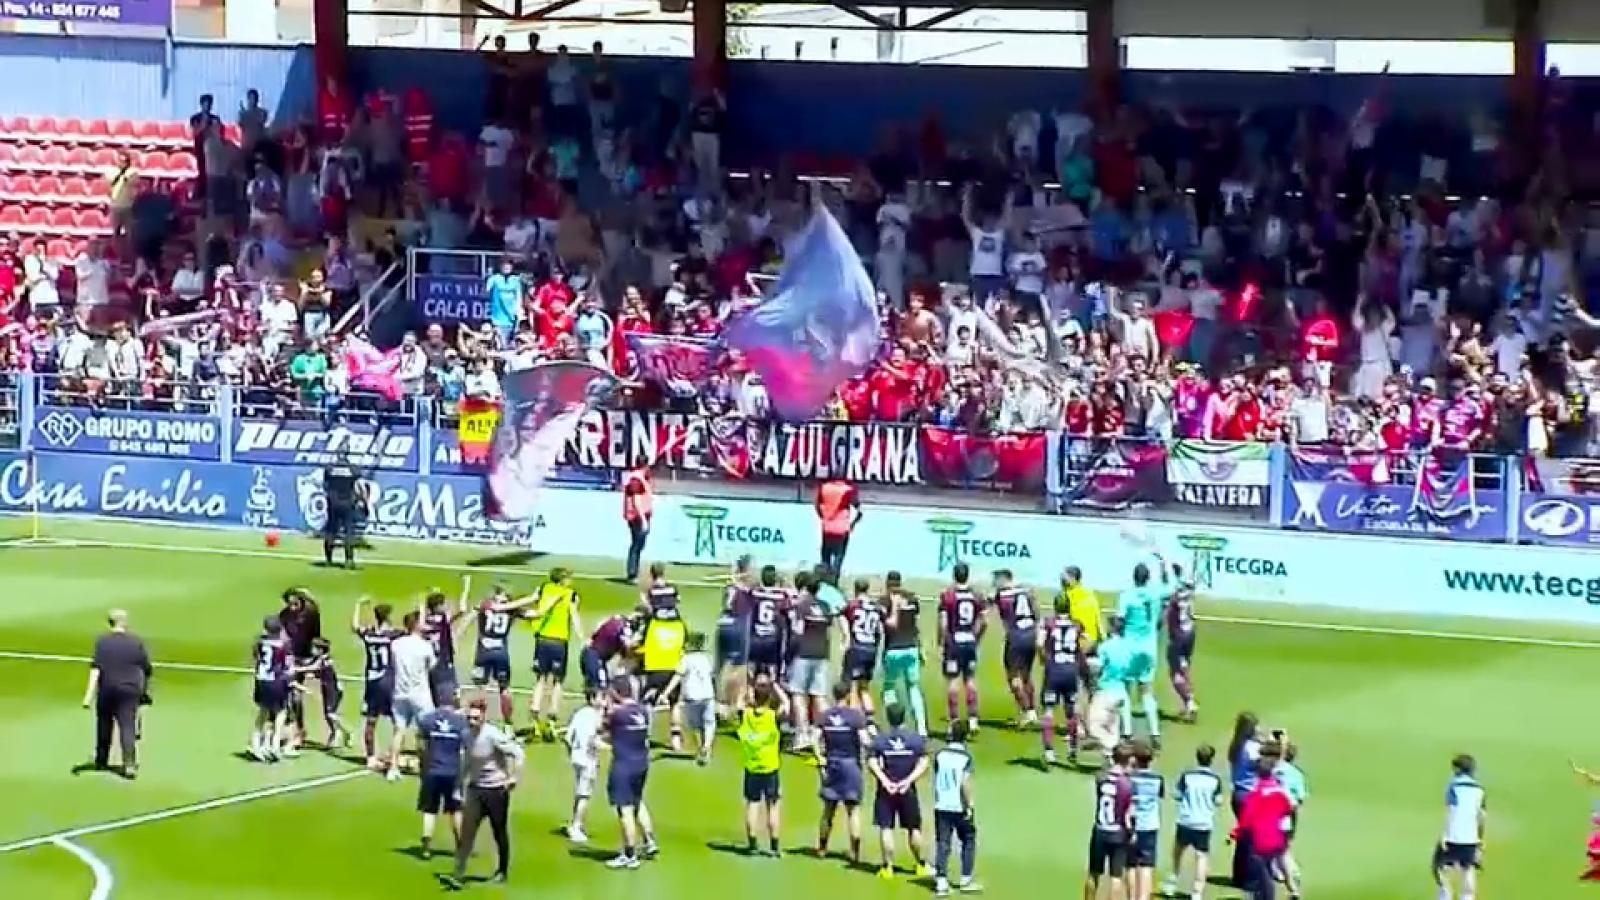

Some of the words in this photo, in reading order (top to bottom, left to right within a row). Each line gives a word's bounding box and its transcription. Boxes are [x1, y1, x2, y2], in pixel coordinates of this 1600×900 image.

[424, 298, 468, 318] CALA
[84, 416, 151, 438] GRUPO
[156, 420, 215, 442] ROMO
[555, 408, 709, 469] RENTE
[762, 421, 925, 484] AZULGRANA
[2, 459, 89, 508] Casa
[101, 465, 227, 516] Emilio
[716, 524, 786, 545] TECGRA
[960, 539, 1031, 559] TECGRA
[1214, 556, 1288, 577] TECGRA
[484, 609, 509, 634] 19
[759, 600, 775, 623] 6
[959, 600, 975, 626] 9
